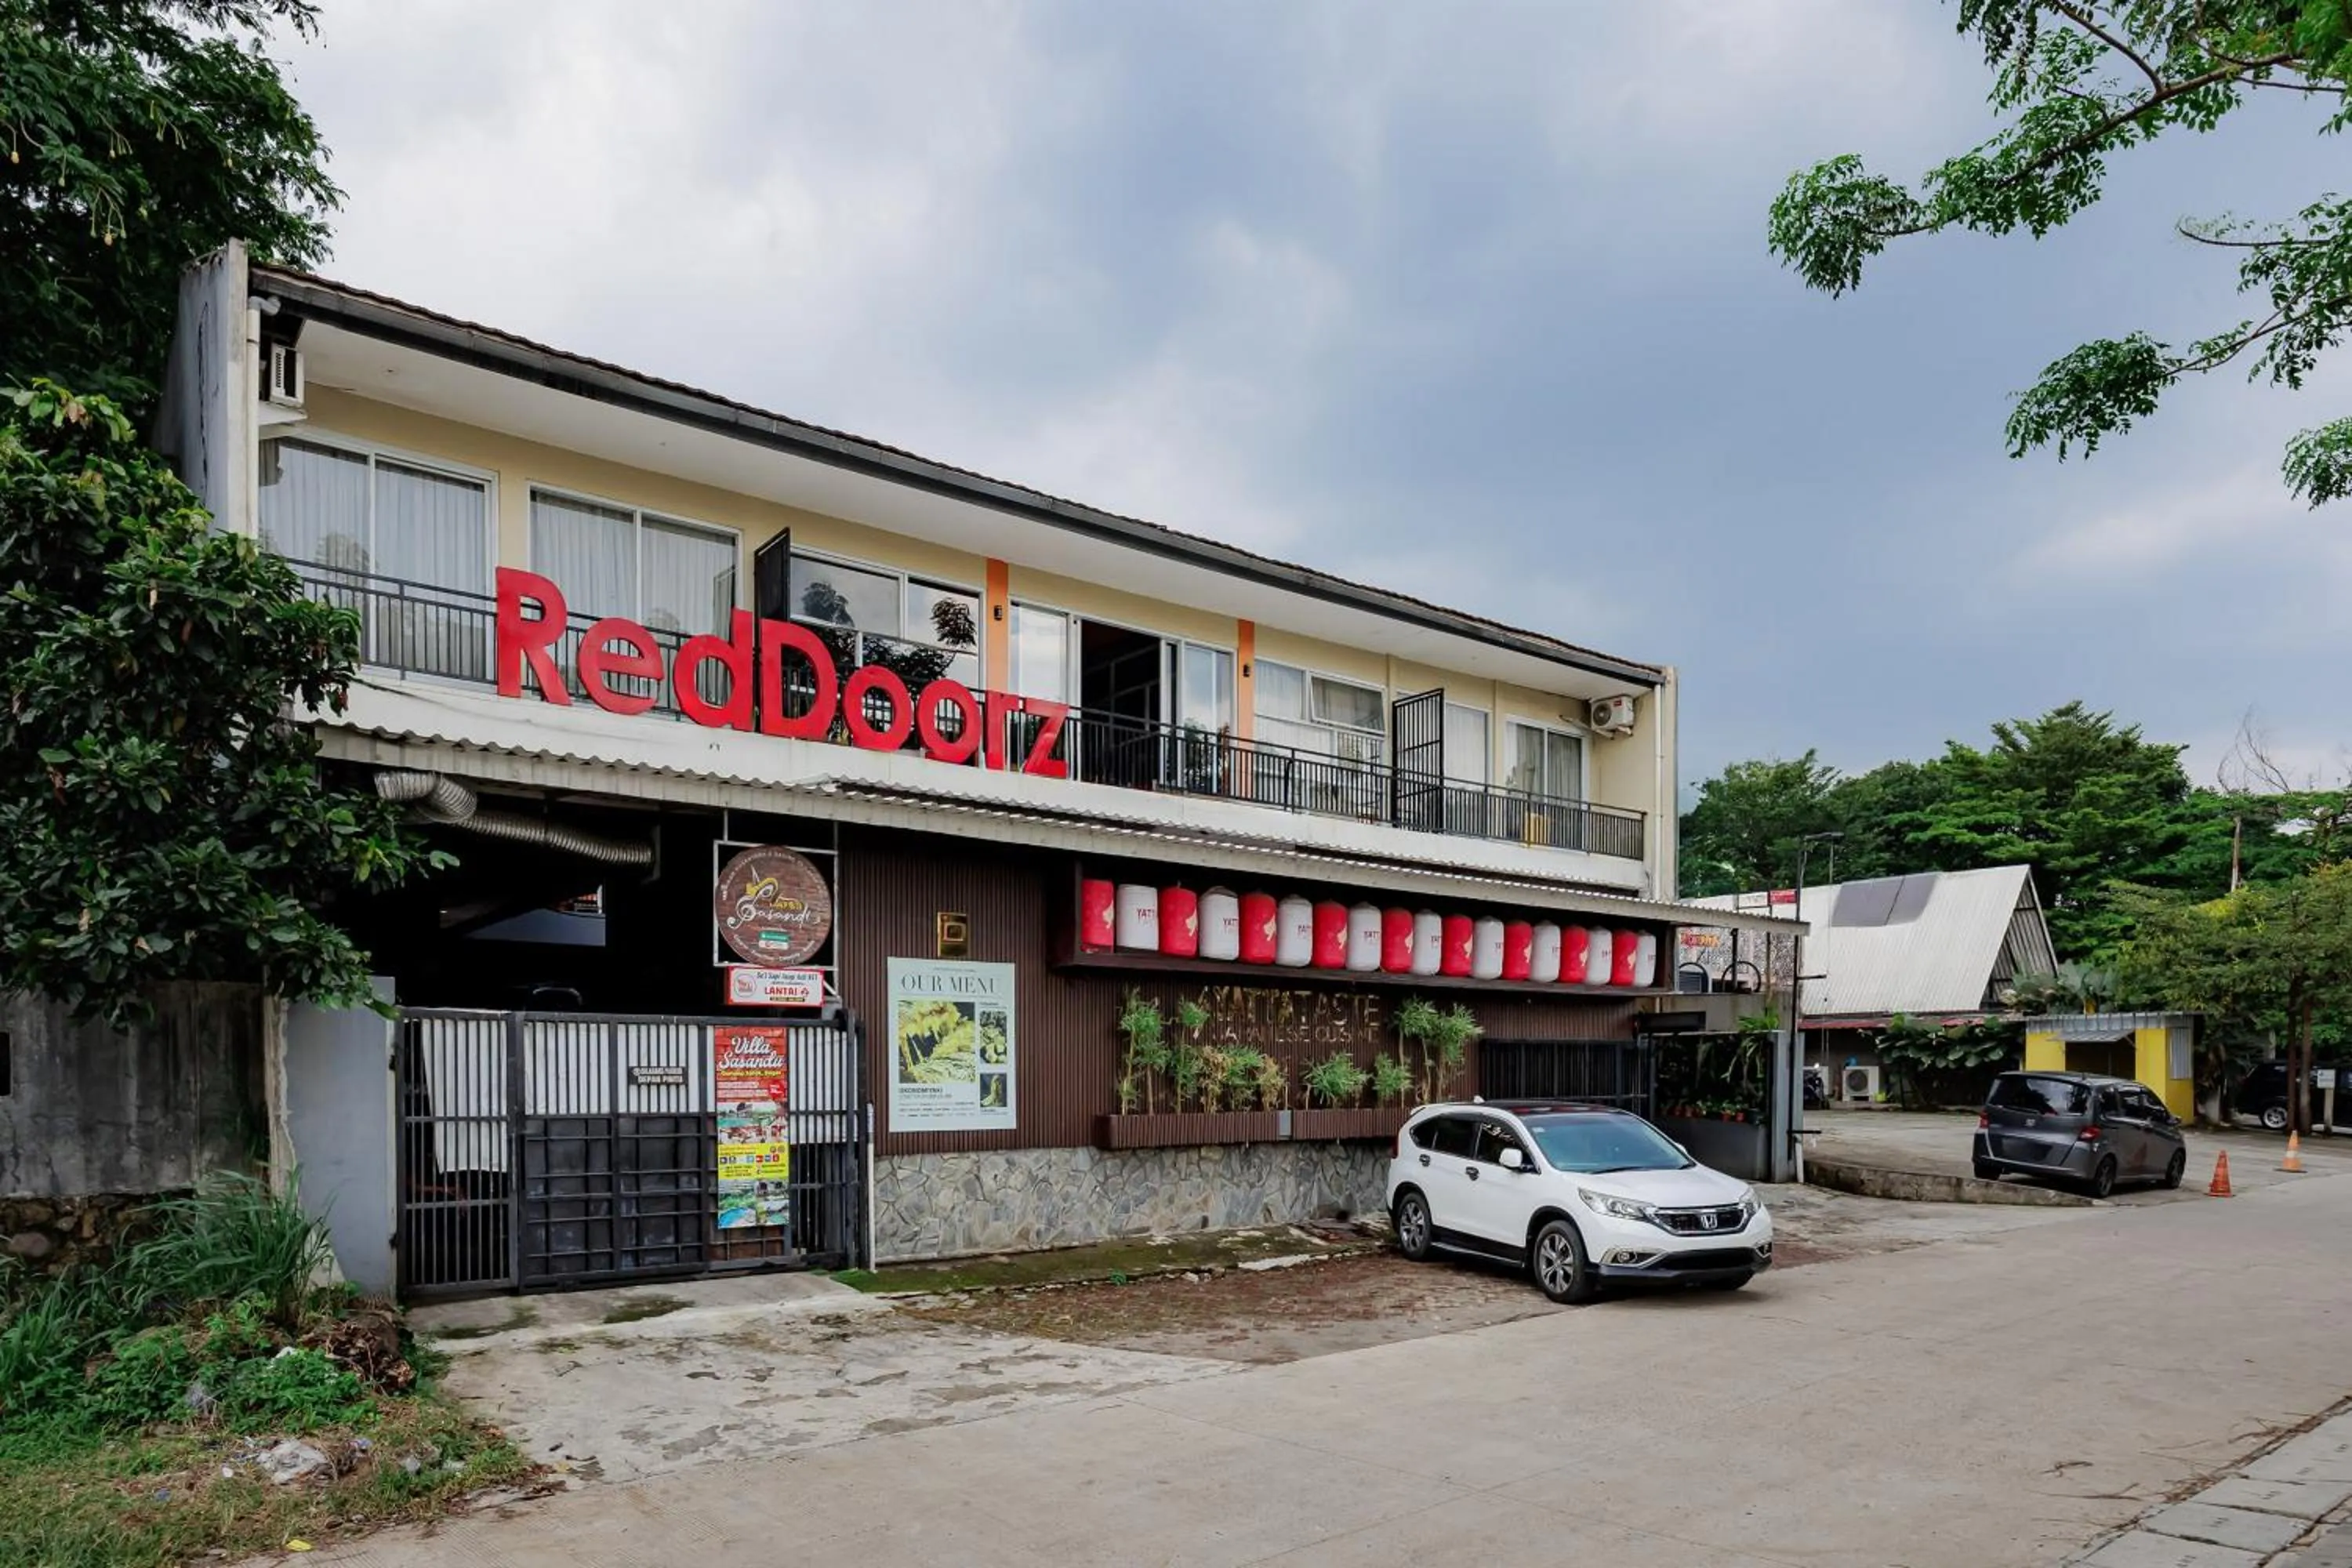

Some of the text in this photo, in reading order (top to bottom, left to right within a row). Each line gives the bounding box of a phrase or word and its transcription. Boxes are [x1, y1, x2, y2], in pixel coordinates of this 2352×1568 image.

[495, 566, 1069, 779] RedDoorz
[765, 987, 797, 996] LANTAI
[902, 974, 943, 992] OUR
[731, 1036, 772, 1054] Villa
